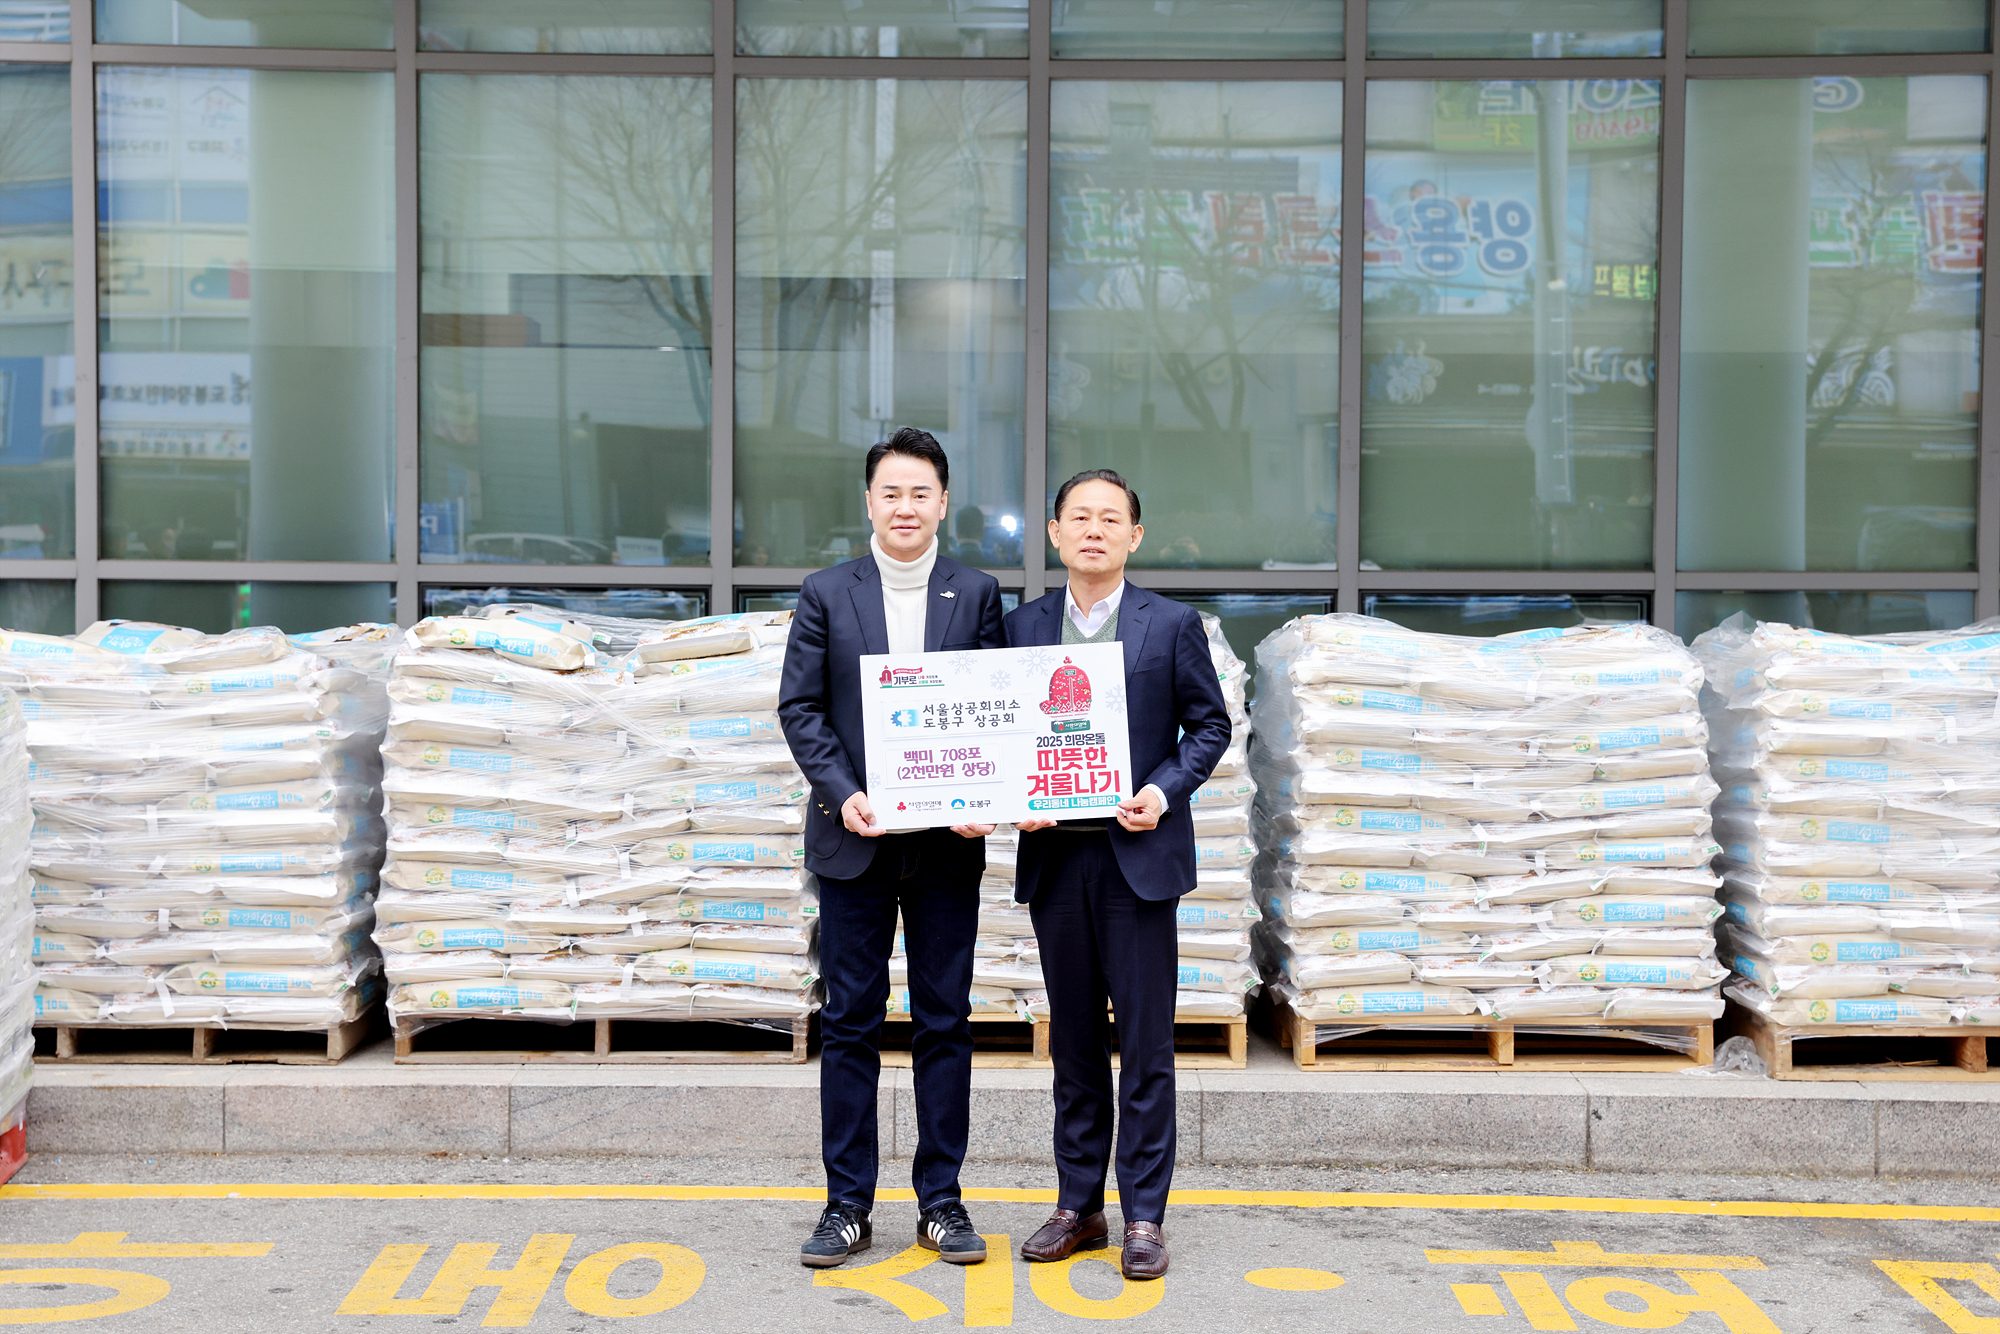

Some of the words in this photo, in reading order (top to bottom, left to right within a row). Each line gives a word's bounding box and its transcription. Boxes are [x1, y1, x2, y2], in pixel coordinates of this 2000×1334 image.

[893, 675, 917, 686] 기부로
[923, 699, 1020, 716] 서울상공회의소
[923, 716, 964, 730] 도봉구
[974, 713, 1014, 728] 상공회
[1036, 735, 1062, 747] 2025
[1064, 732, 1105, 746] 희망온돌
[904, 750, 933, 764] 백미
[940, 747, 981, 762] 708포
[1037, 746, 1107, 771] 따뜻한
[897, 763, 954, 780] (2천만원
[961, 761, 995, 777] 상당)
[1027, 770, 1120, 796] 겨울나기
[969, 800, 991, 808] 도봉구
[1033, 798, 1069, 809] 우리동네
[1071, 796, 1116, 807] 나눔캠페인
[757, 848, 768, 857] 10
[767, 907, 777, 916] 10
[1208, 910, 1218, 920] 10
[293, 915, 304, 924] 10
[1203, 972, 1213, 982] 10
